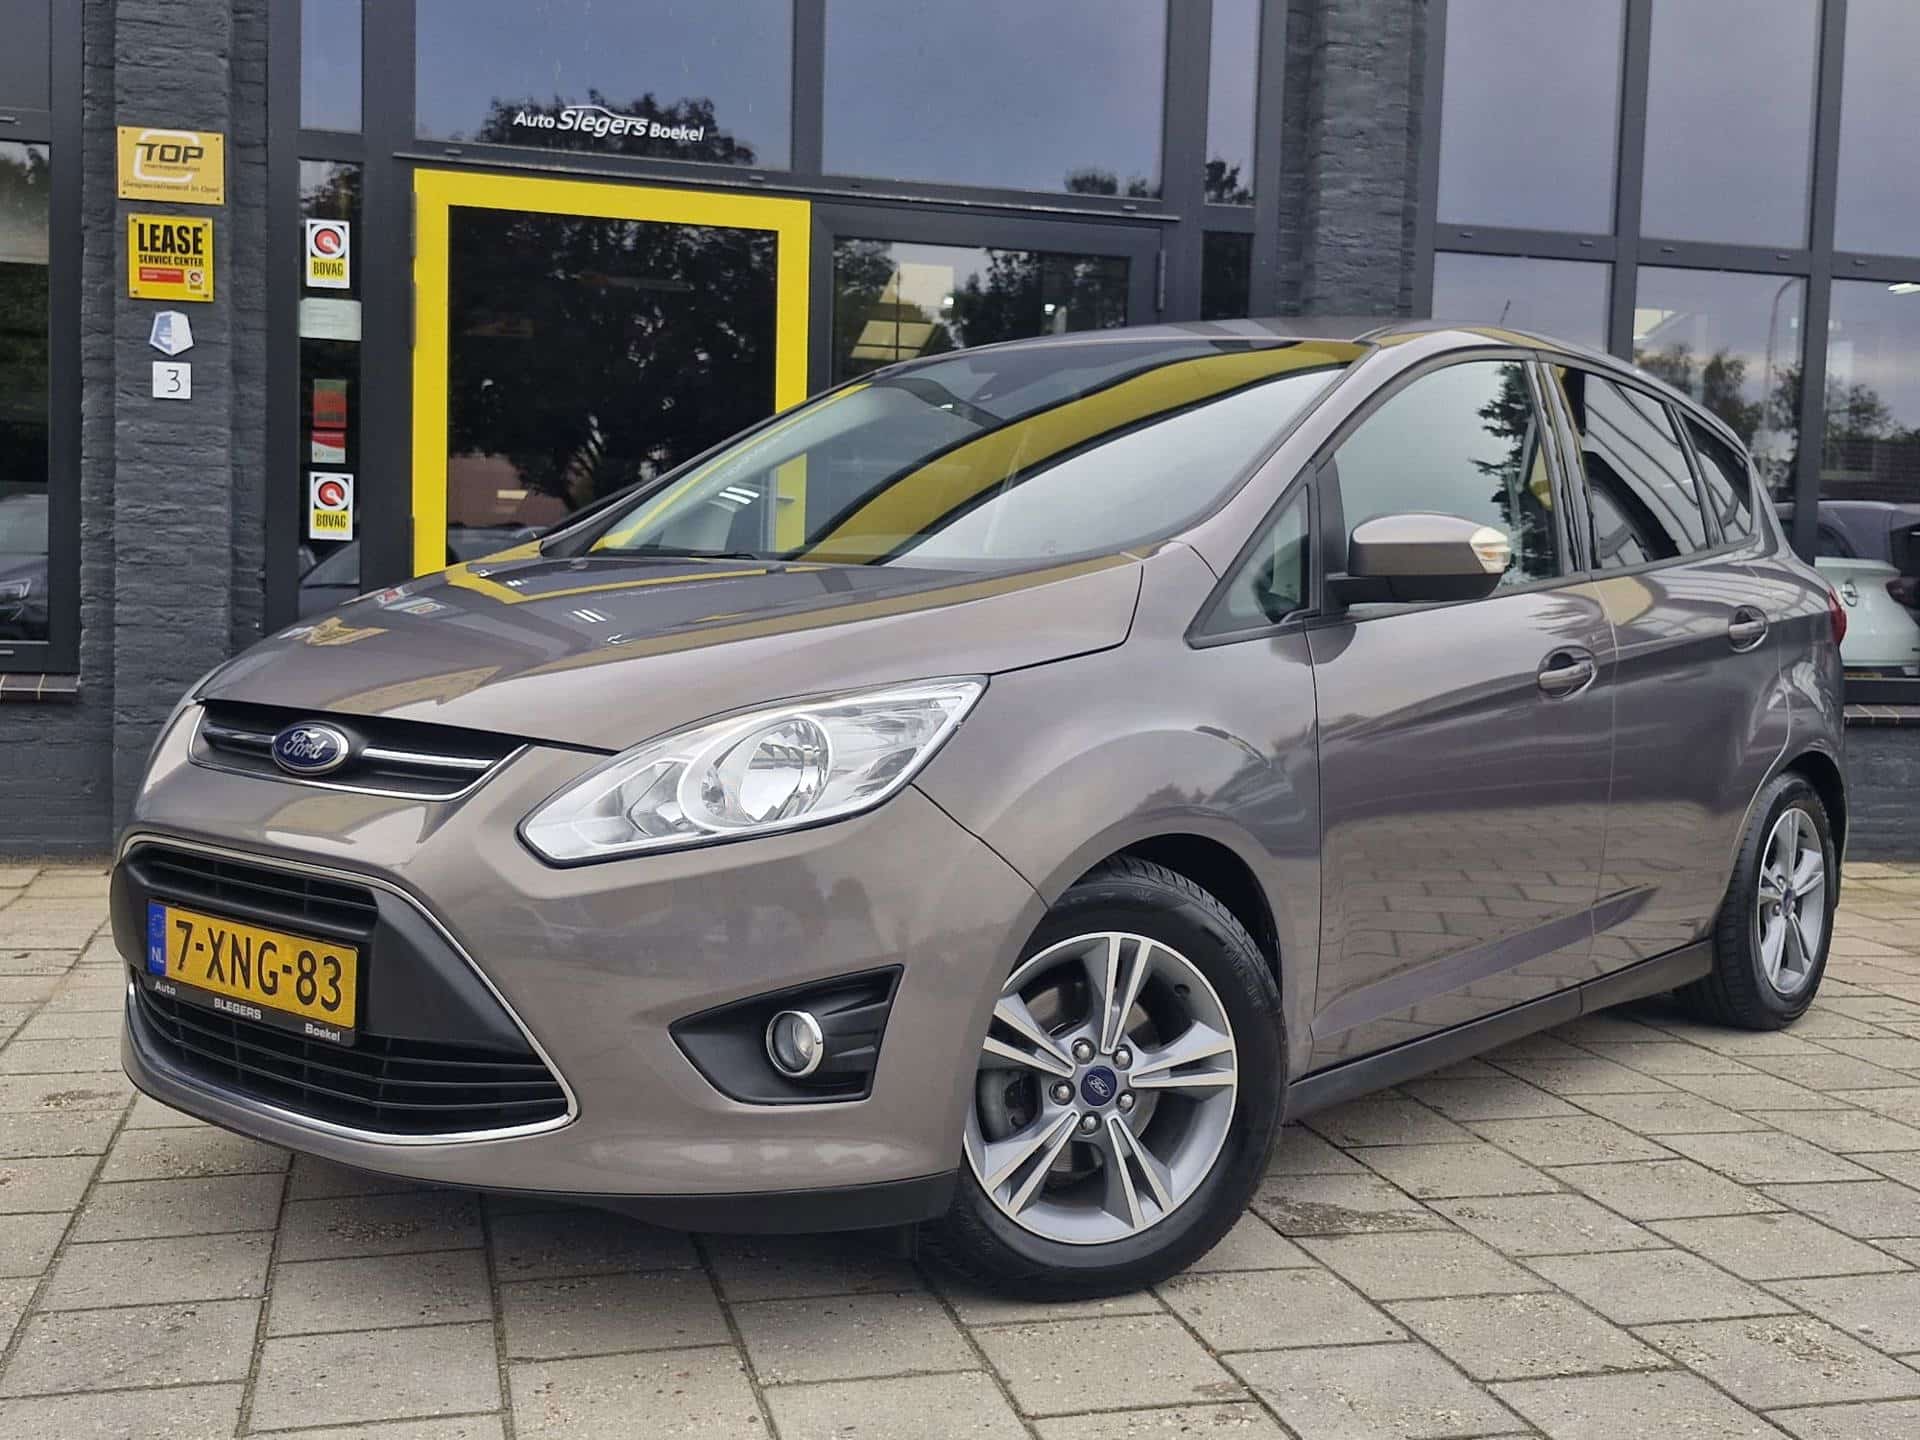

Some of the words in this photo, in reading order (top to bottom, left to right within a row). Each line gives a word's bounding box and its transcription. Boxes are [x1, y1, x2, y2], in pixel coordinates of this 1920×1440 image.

[513, 111, 556, 128] Auto
[557, 109, 648, 137] Slegers
[650, 122, 705, 141] Boekel
[136, 142, 204, 164] TOP
[138, 223, 204, 255] LEASE
[139, 254, 173, 265] SERVICE
[174, 256, 204, 267] CENTER
[313, 261, 344, 276] BOVAG
[167, 369, 181, 393] 3
[316, 513, 346, 528] BOVAG
[283, 730, 328, 760] Ford
[151, 946, 165, 964] NL
[175, 919, 342, 1012] 7-XNG-83
[154, 981, 177, 996] Auto
[304, 1023, 341, 1042] Boekel
